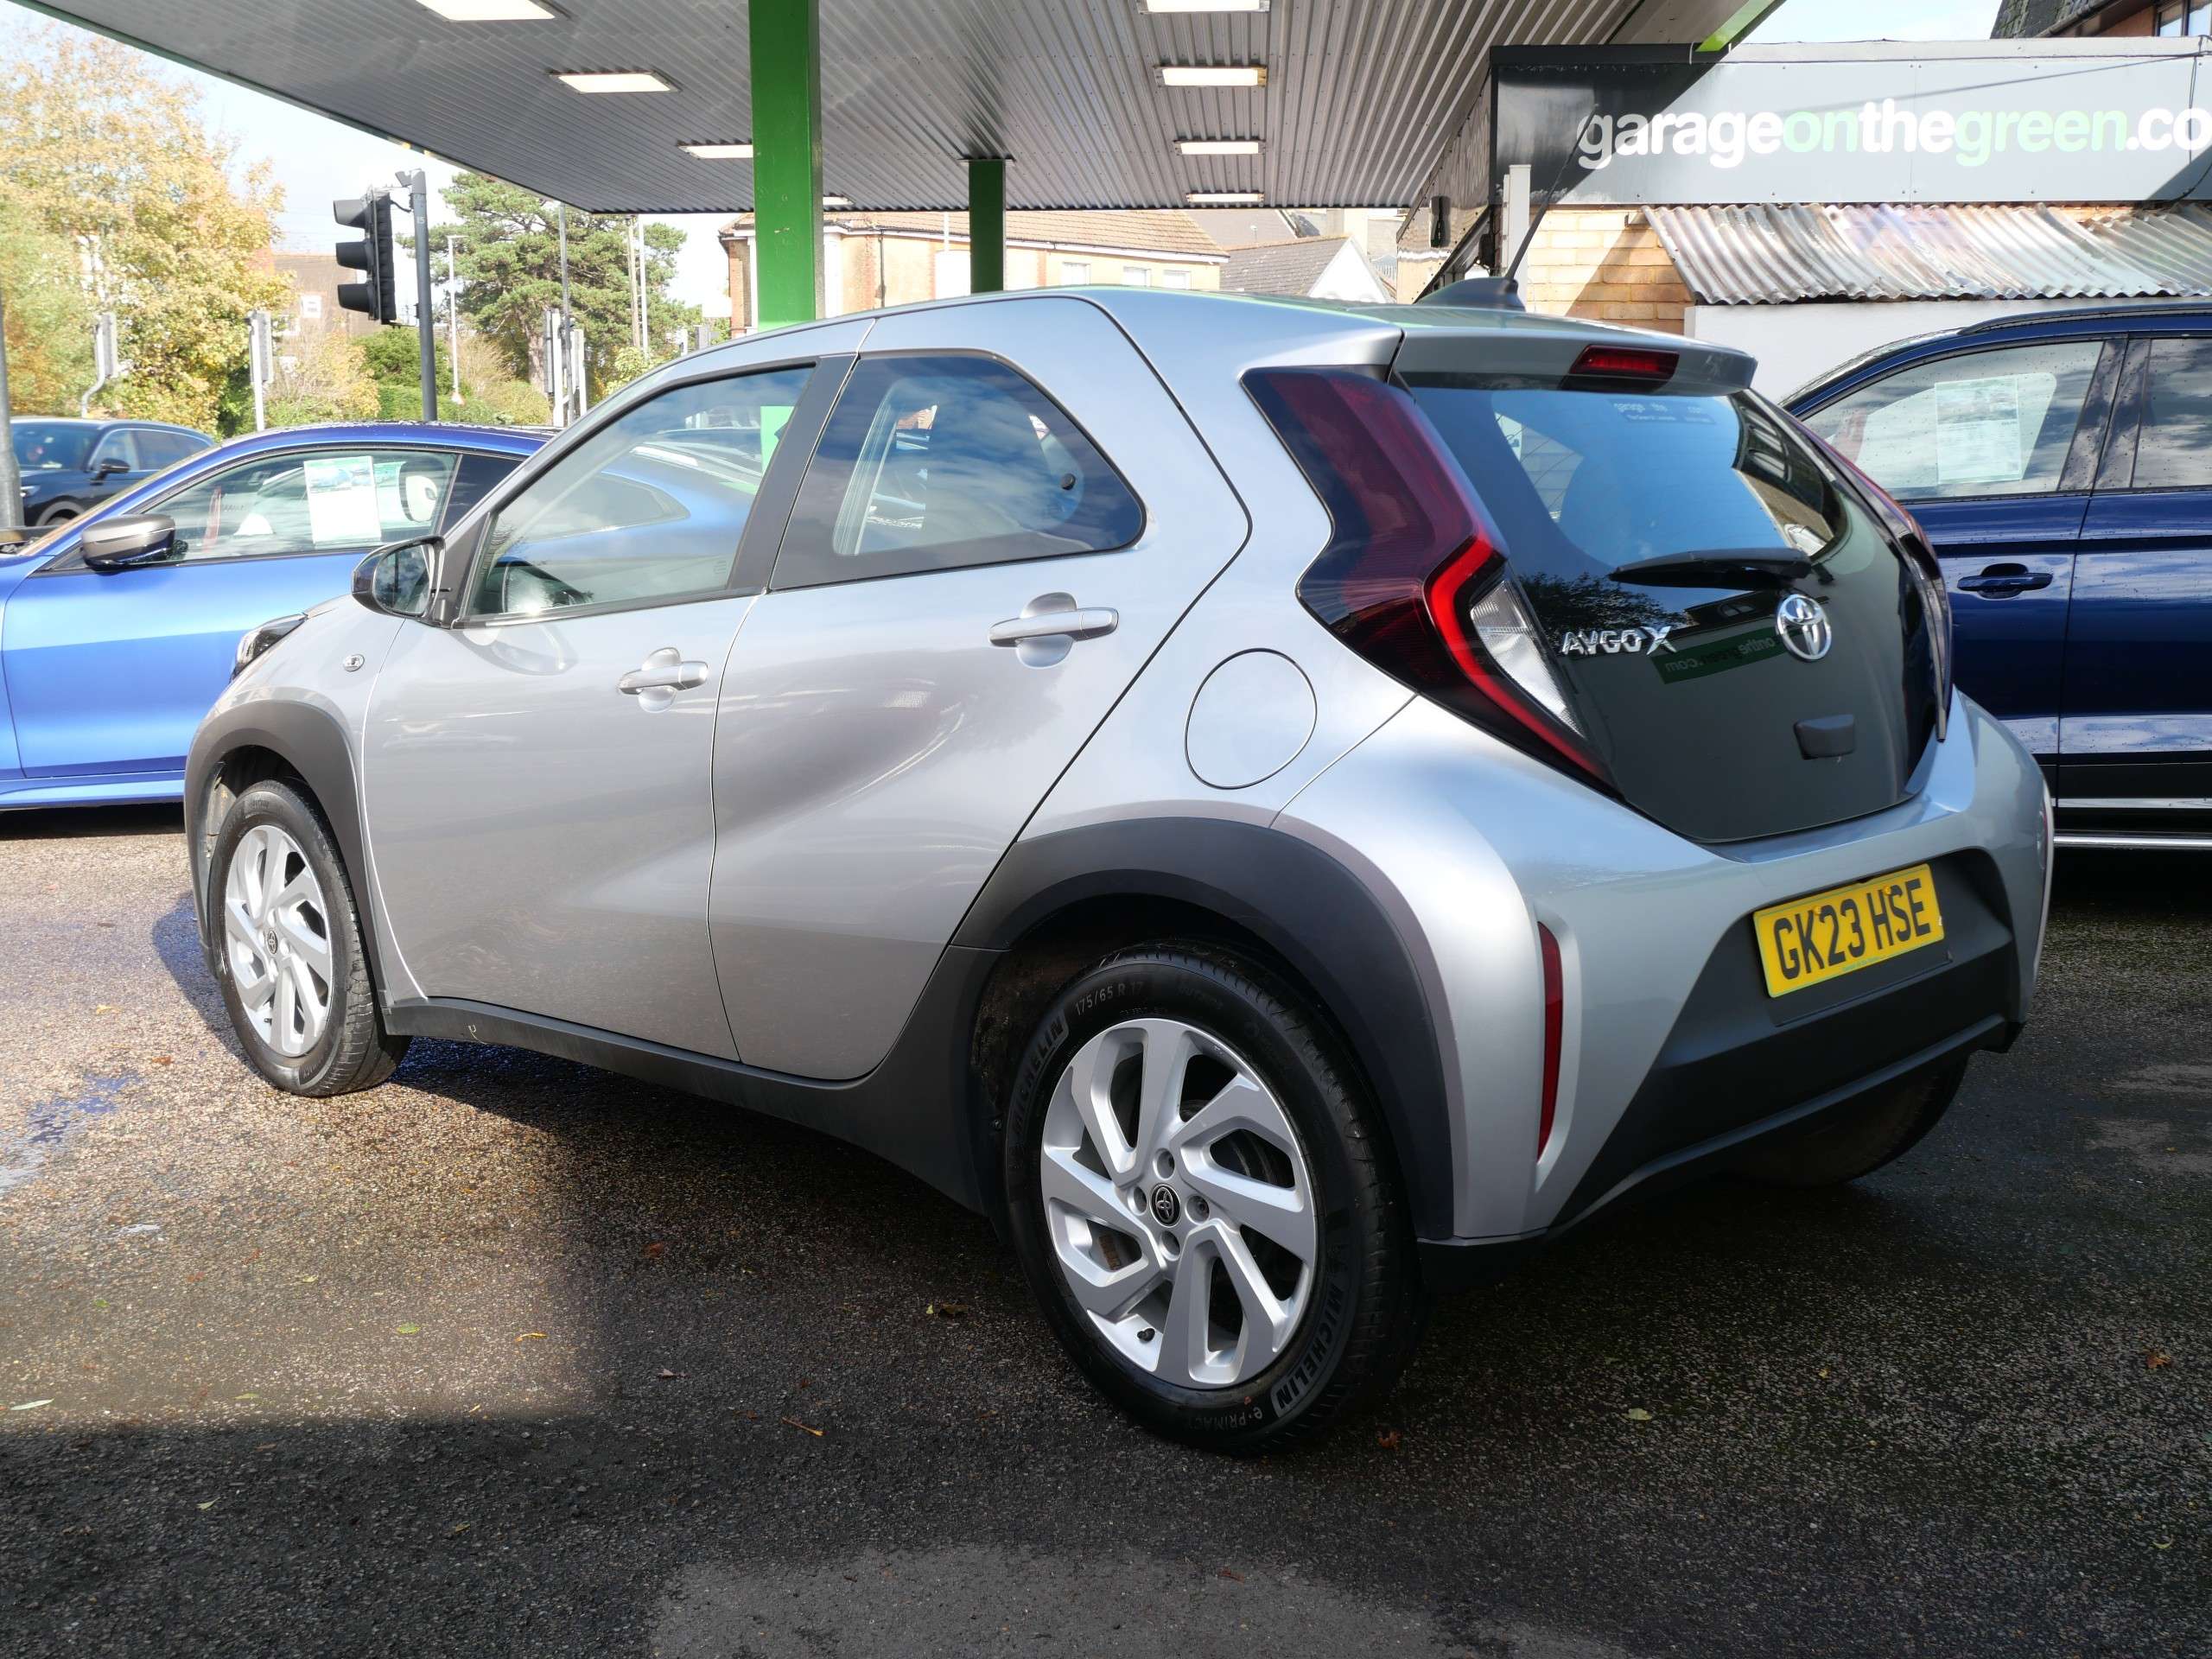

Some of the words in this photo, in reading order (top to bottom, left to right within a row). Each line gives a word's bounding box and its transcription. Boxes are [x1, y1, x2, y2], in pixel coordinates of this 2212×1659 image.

[1774, 899, 1866, 980] GK23
[1866, 878, 1930, 950] HSE
[1075, 985, 1114, 1016] 175/65
[1275, 1282, 1344, 1410] MICHELIN
